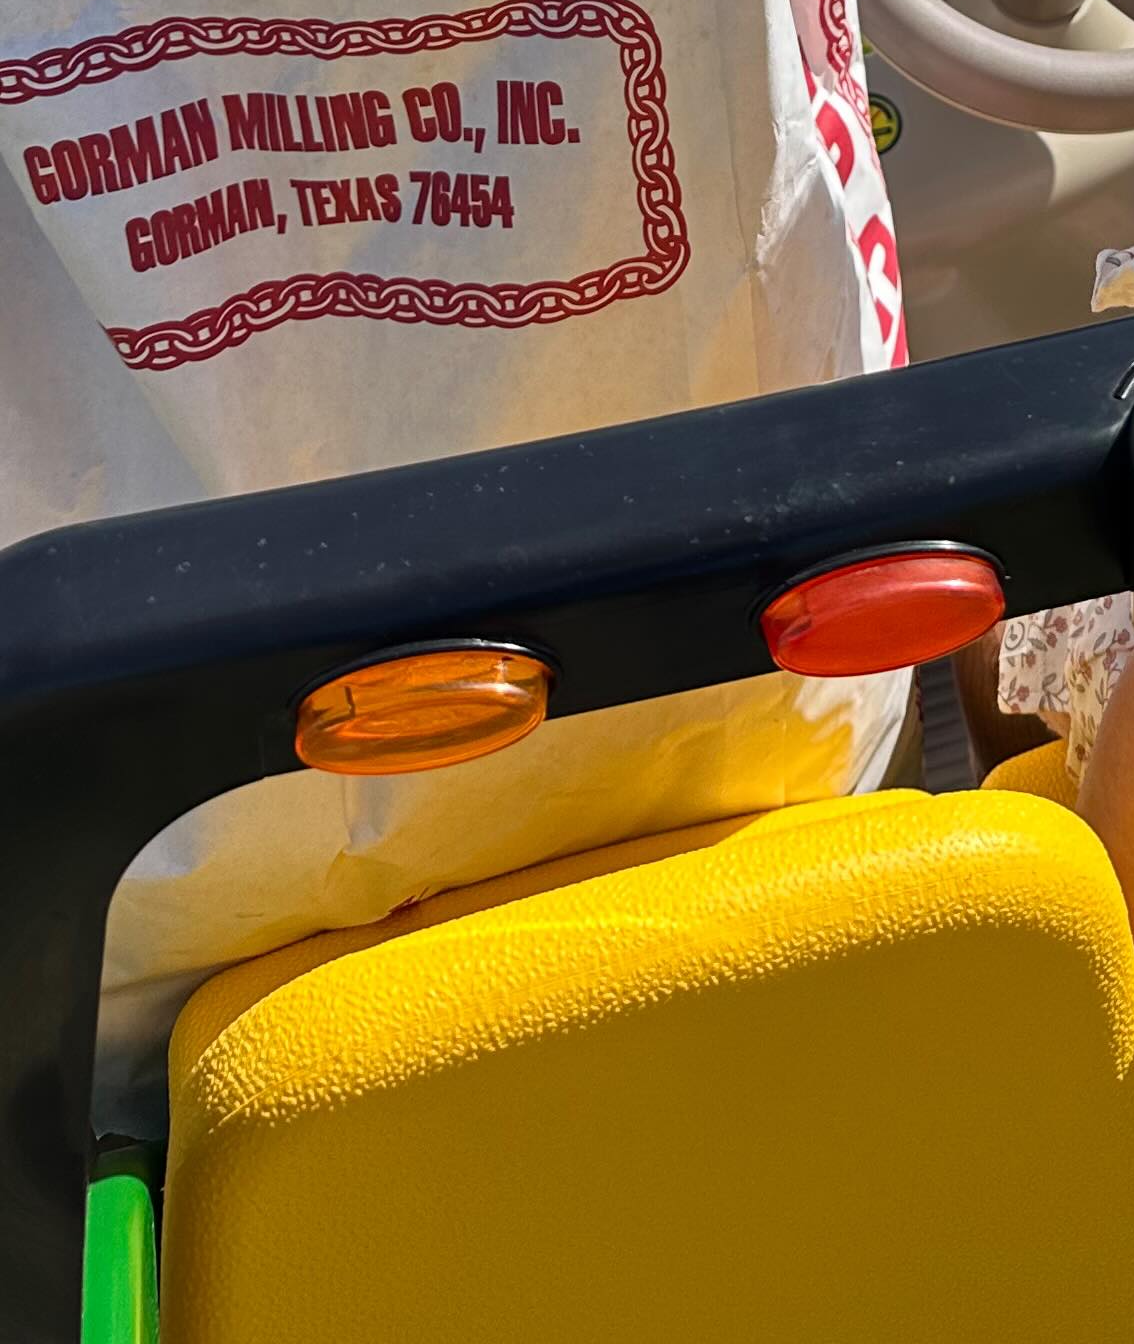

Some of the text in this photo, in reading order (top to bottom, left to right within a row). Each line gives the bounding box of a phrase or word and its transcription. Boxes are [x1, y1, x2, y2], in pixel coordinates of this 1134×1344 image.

[23, 80, 580, 205] GORMAN MILLING CO., INC.
[125, 170, 514, 274] GORMAN, TEXAS 76454
